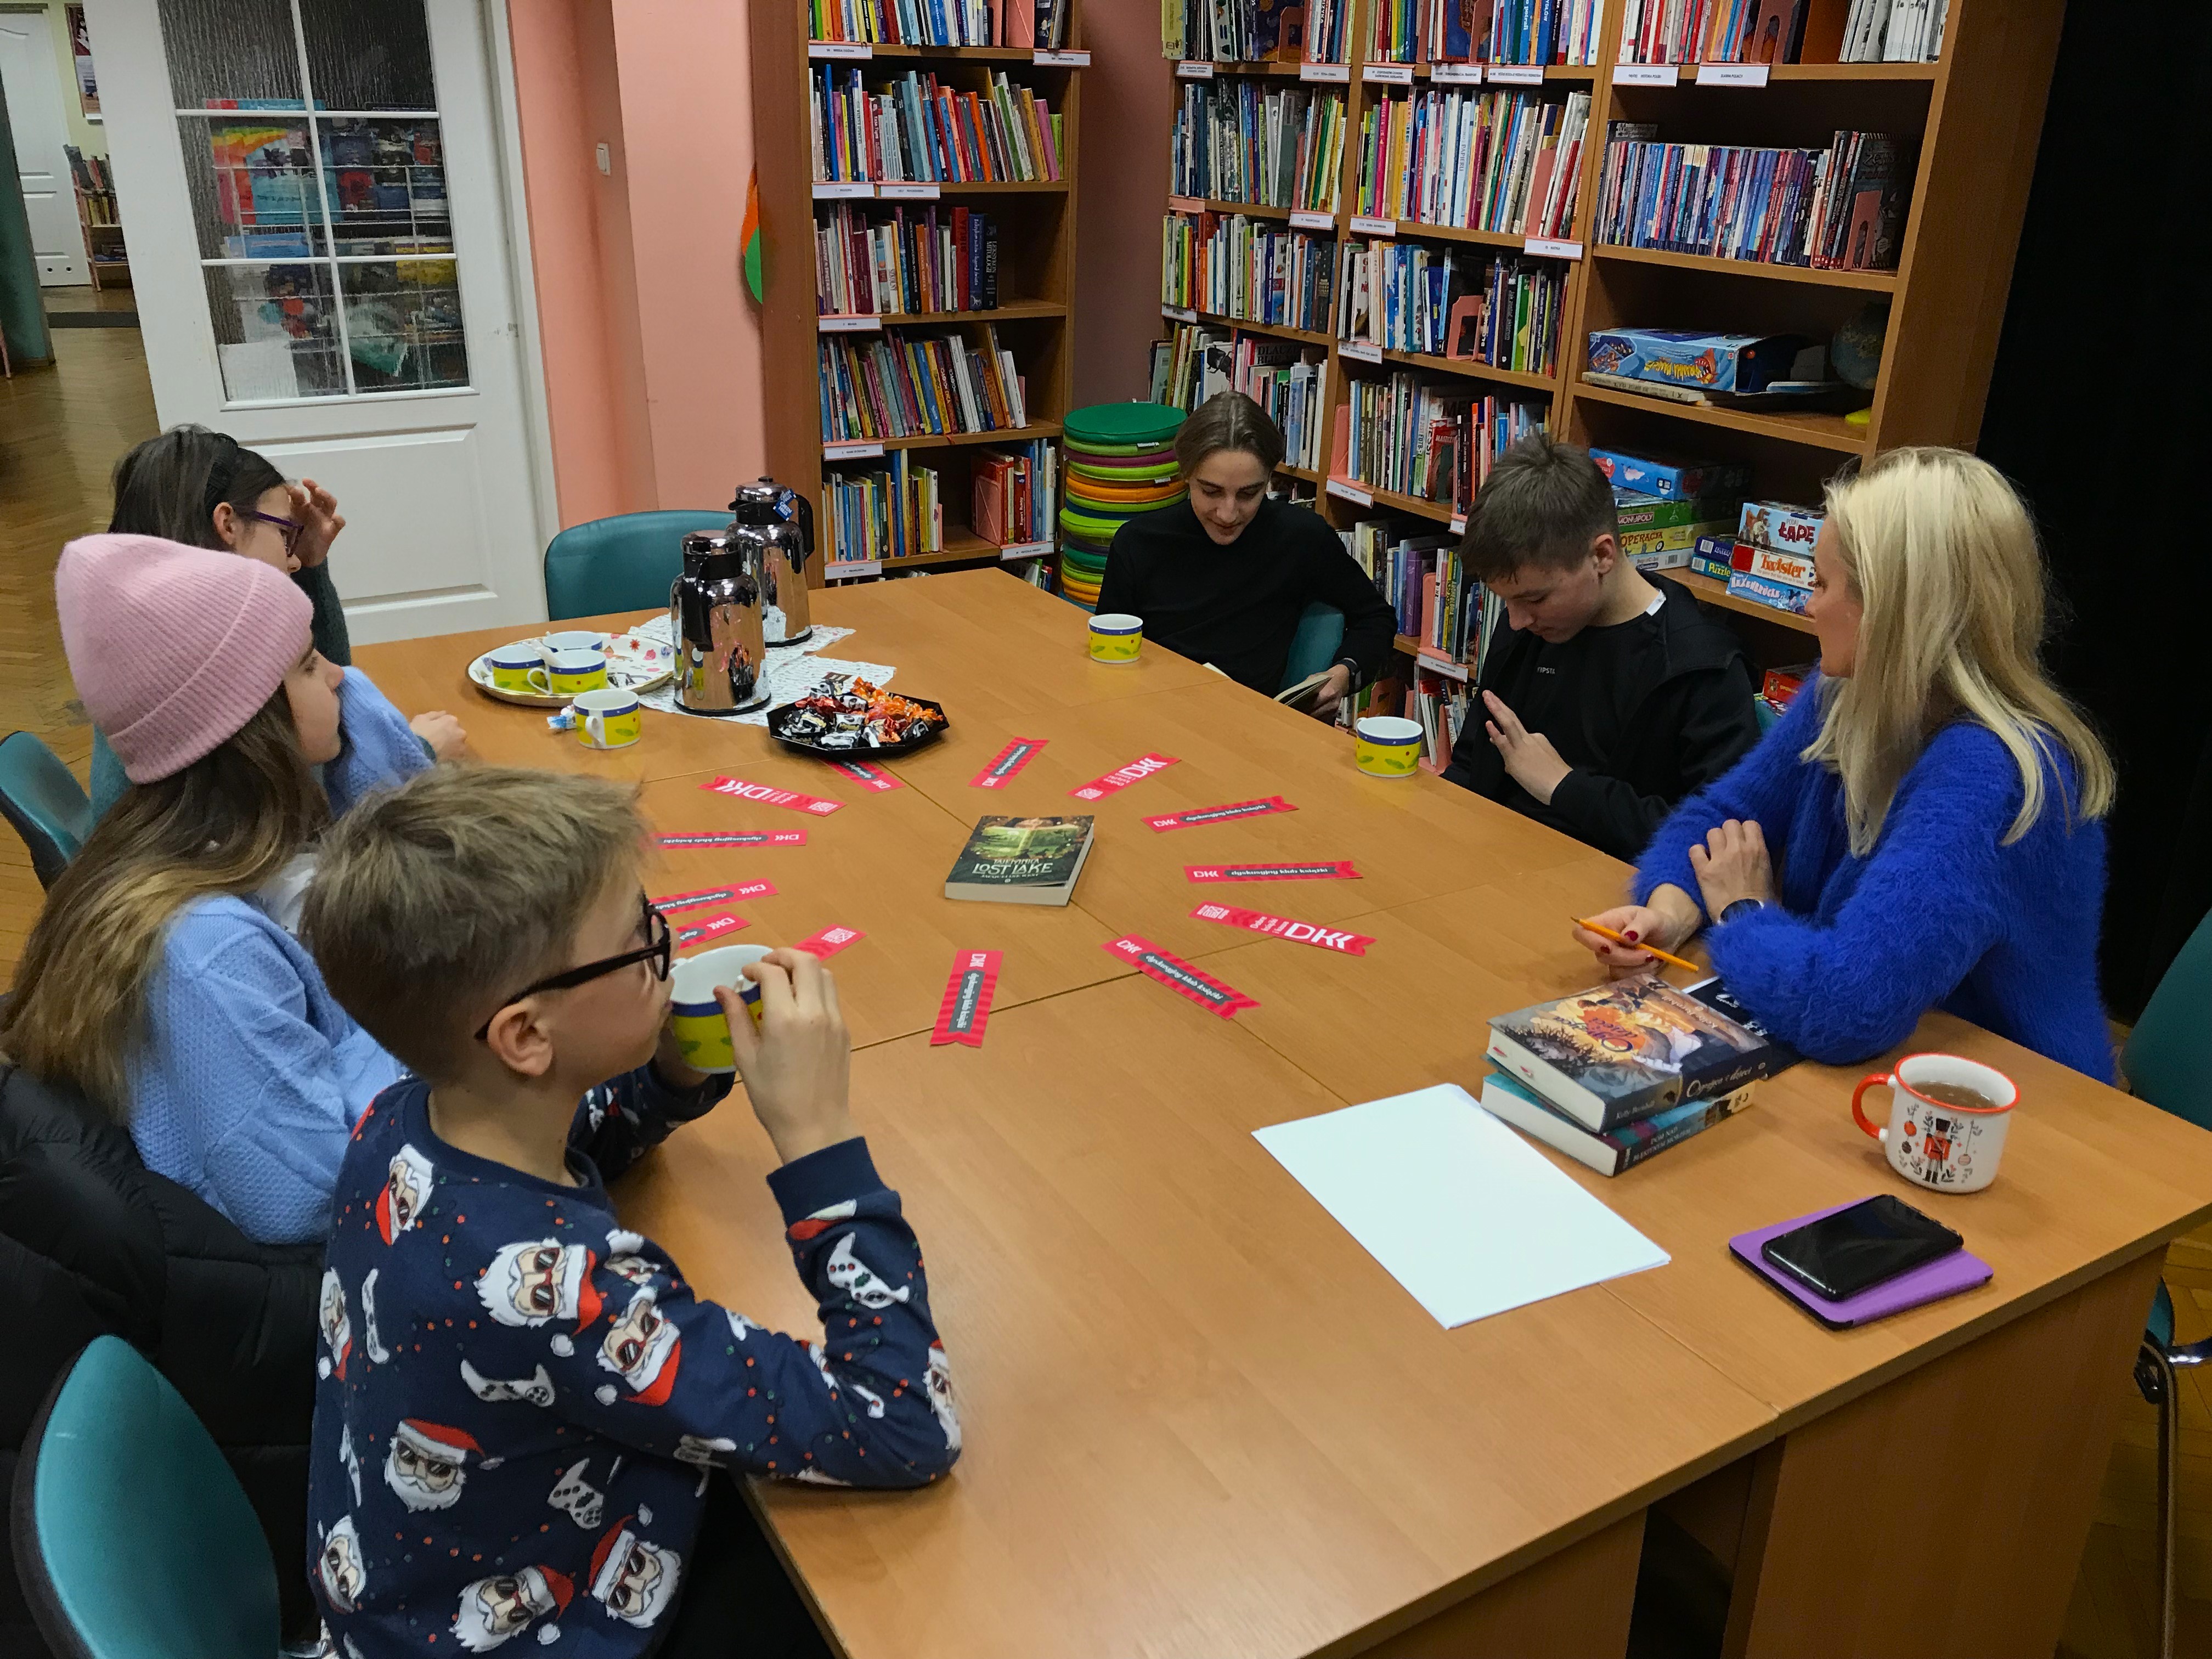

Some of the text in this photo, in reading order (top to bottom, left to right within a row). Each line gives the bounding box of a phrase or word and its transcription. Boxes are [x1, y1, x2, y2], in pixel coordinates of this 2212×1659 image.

[1620, 531, 1663, 546] OPERACJA
[1778, 521, 1816, 545] ŁAPĘ
[1708, 562, 1731, 577] Puzzle
[1761, 553, 1806, 579] Twister
[972, 862, 1053, 876] LOST LAKE
